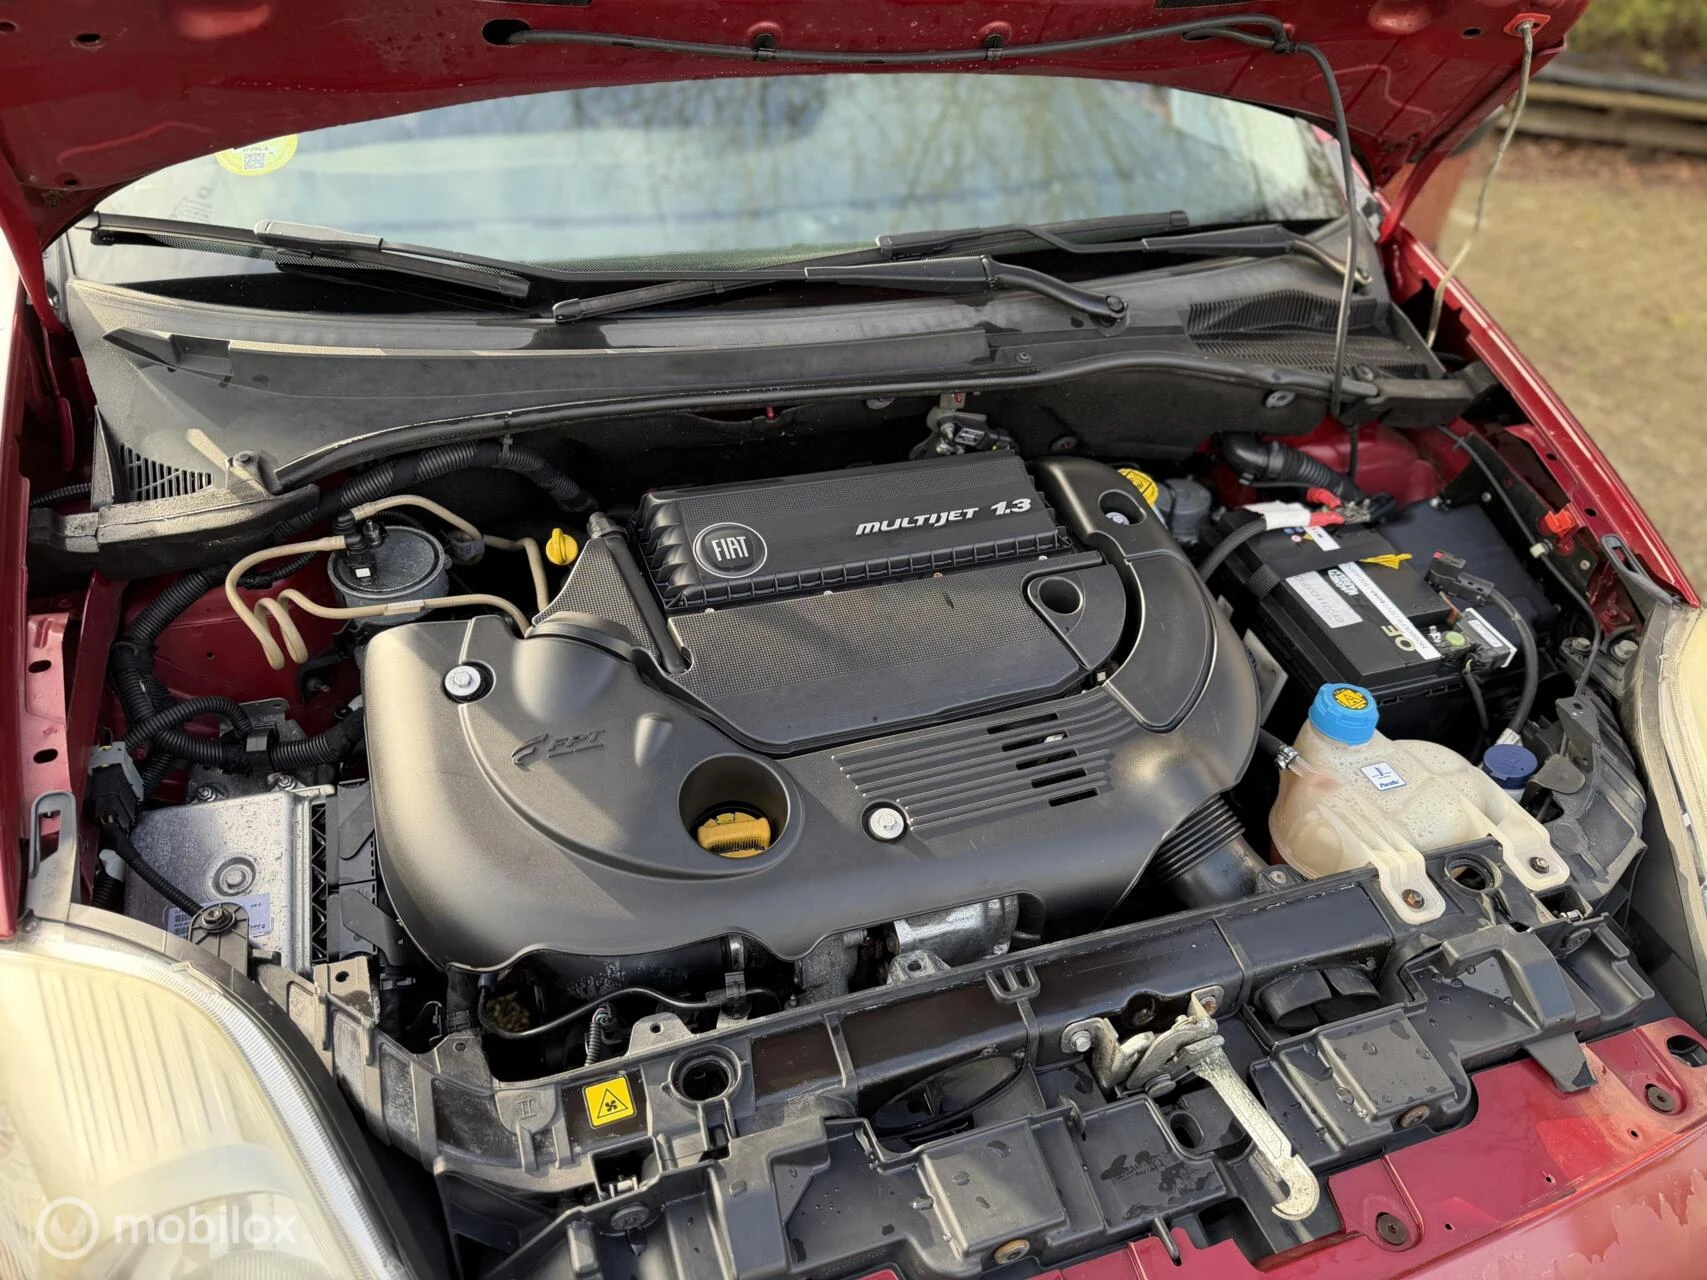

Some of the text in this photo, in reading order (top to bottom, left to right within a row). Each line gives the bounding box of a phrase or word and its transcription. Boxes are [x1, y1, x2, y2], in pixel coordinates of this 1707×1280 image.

[855, 498, 1032, 536] MULTIJET 1.3
[711, 535, 749, 562] FIAT
[1380, 625, 1416, 651] OE
[545, 728, 606, 753] FPT
